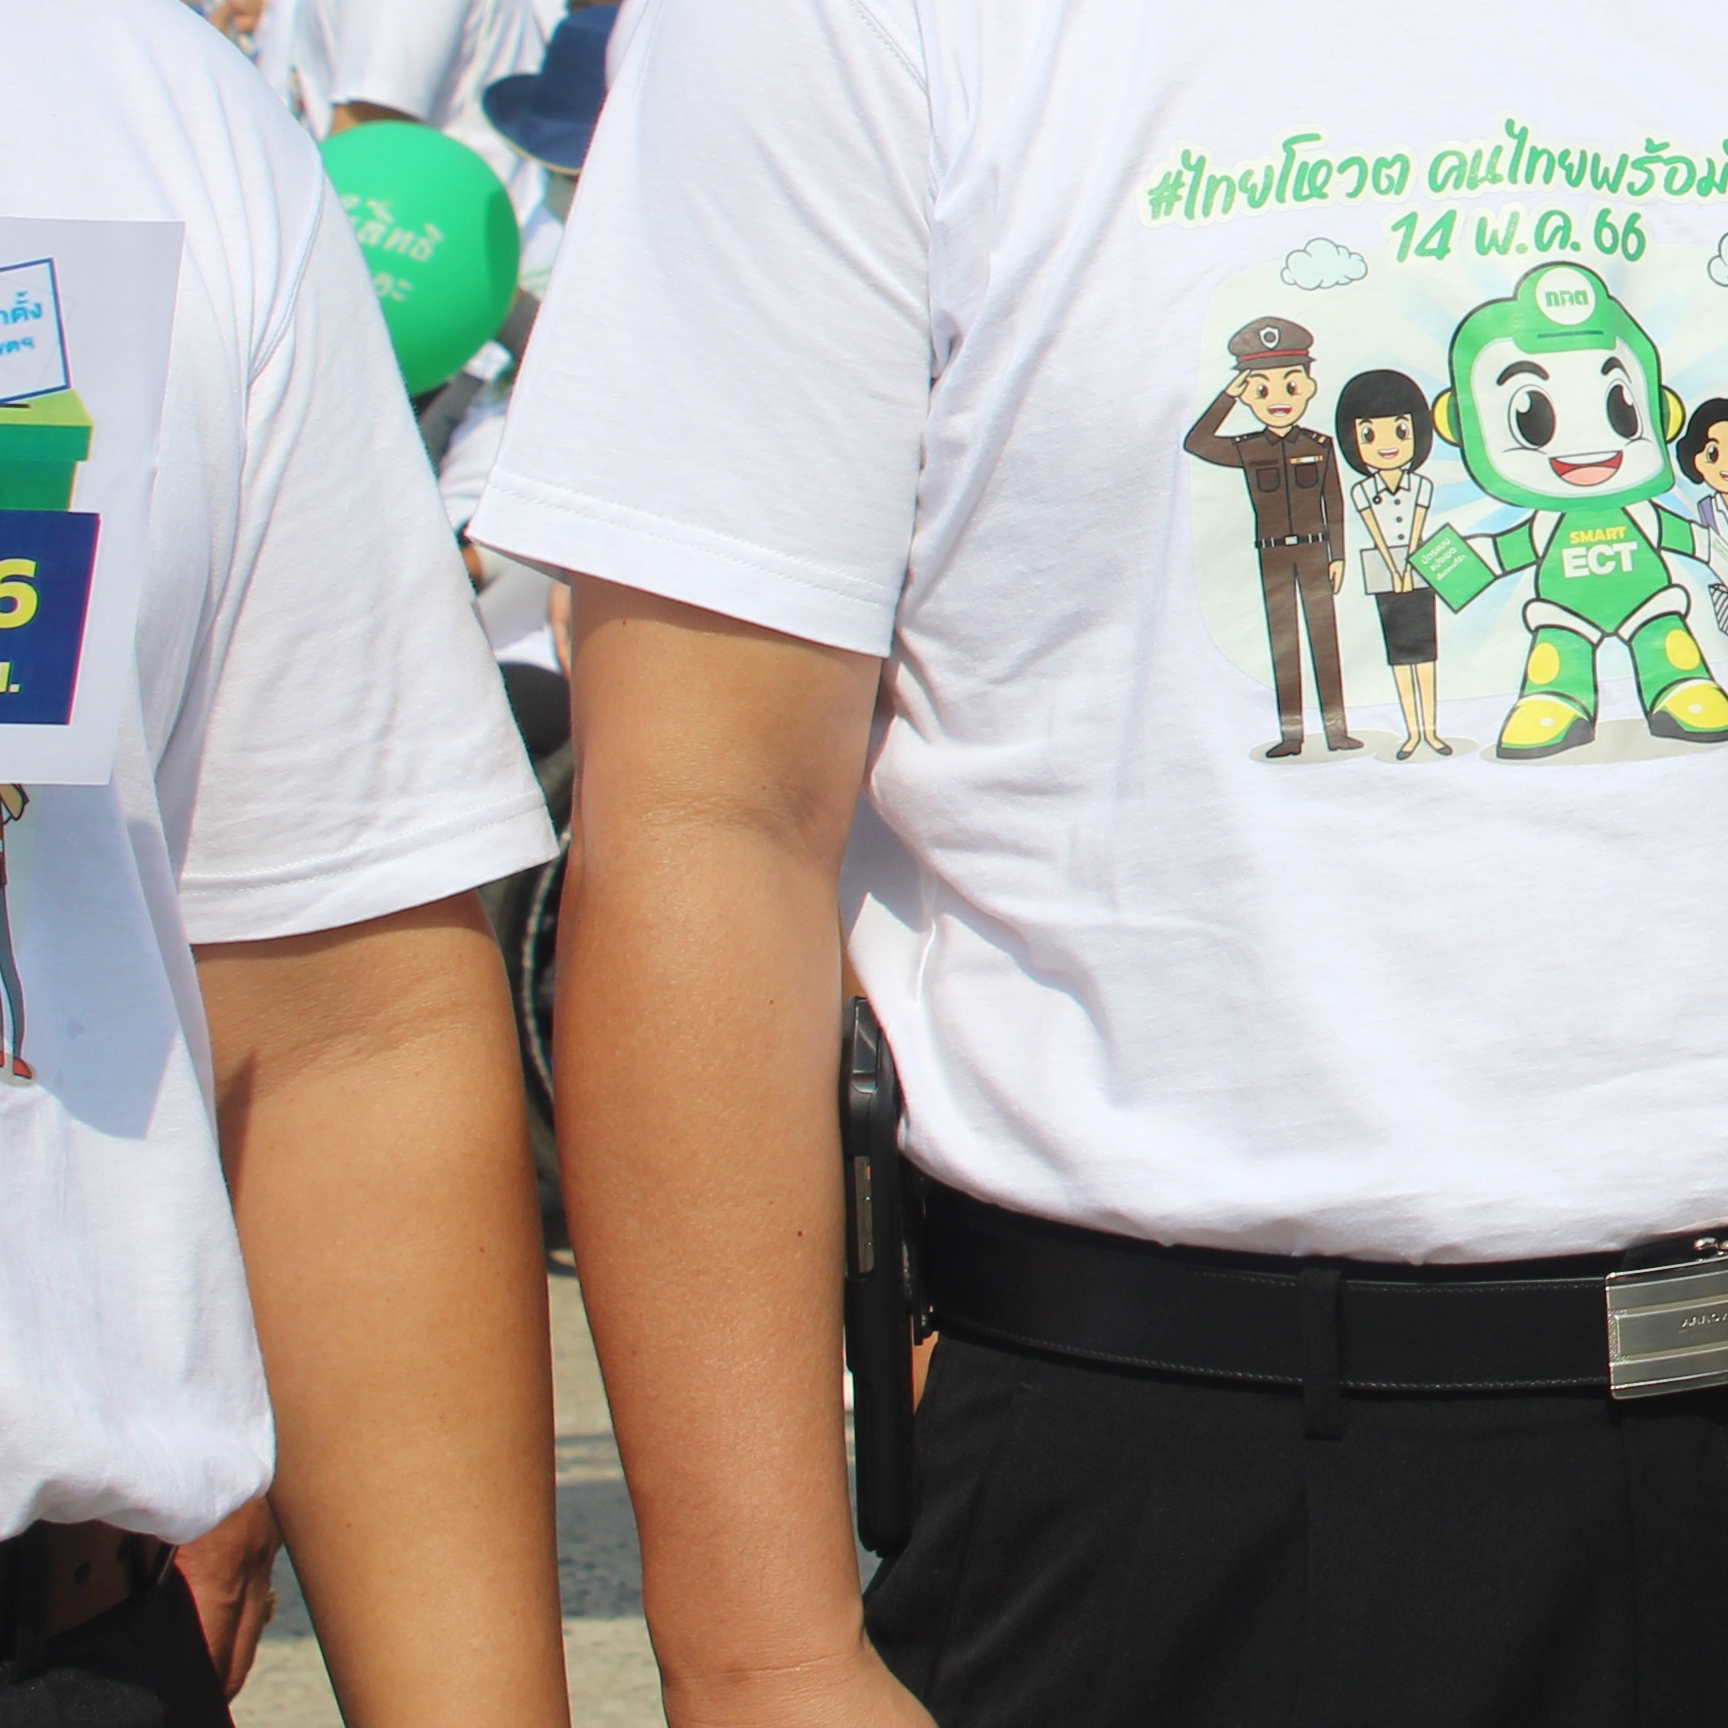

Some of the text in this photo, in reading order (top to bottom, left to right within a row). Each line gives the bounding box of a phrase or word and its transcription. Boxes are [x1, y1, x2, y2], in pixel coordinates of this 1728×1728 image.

[1391, 208, 1647, 262] 14 พ.ค. 66
[1568, 524, 1628, 547] SMART
[1561, 540, 1639, 579] ECT
